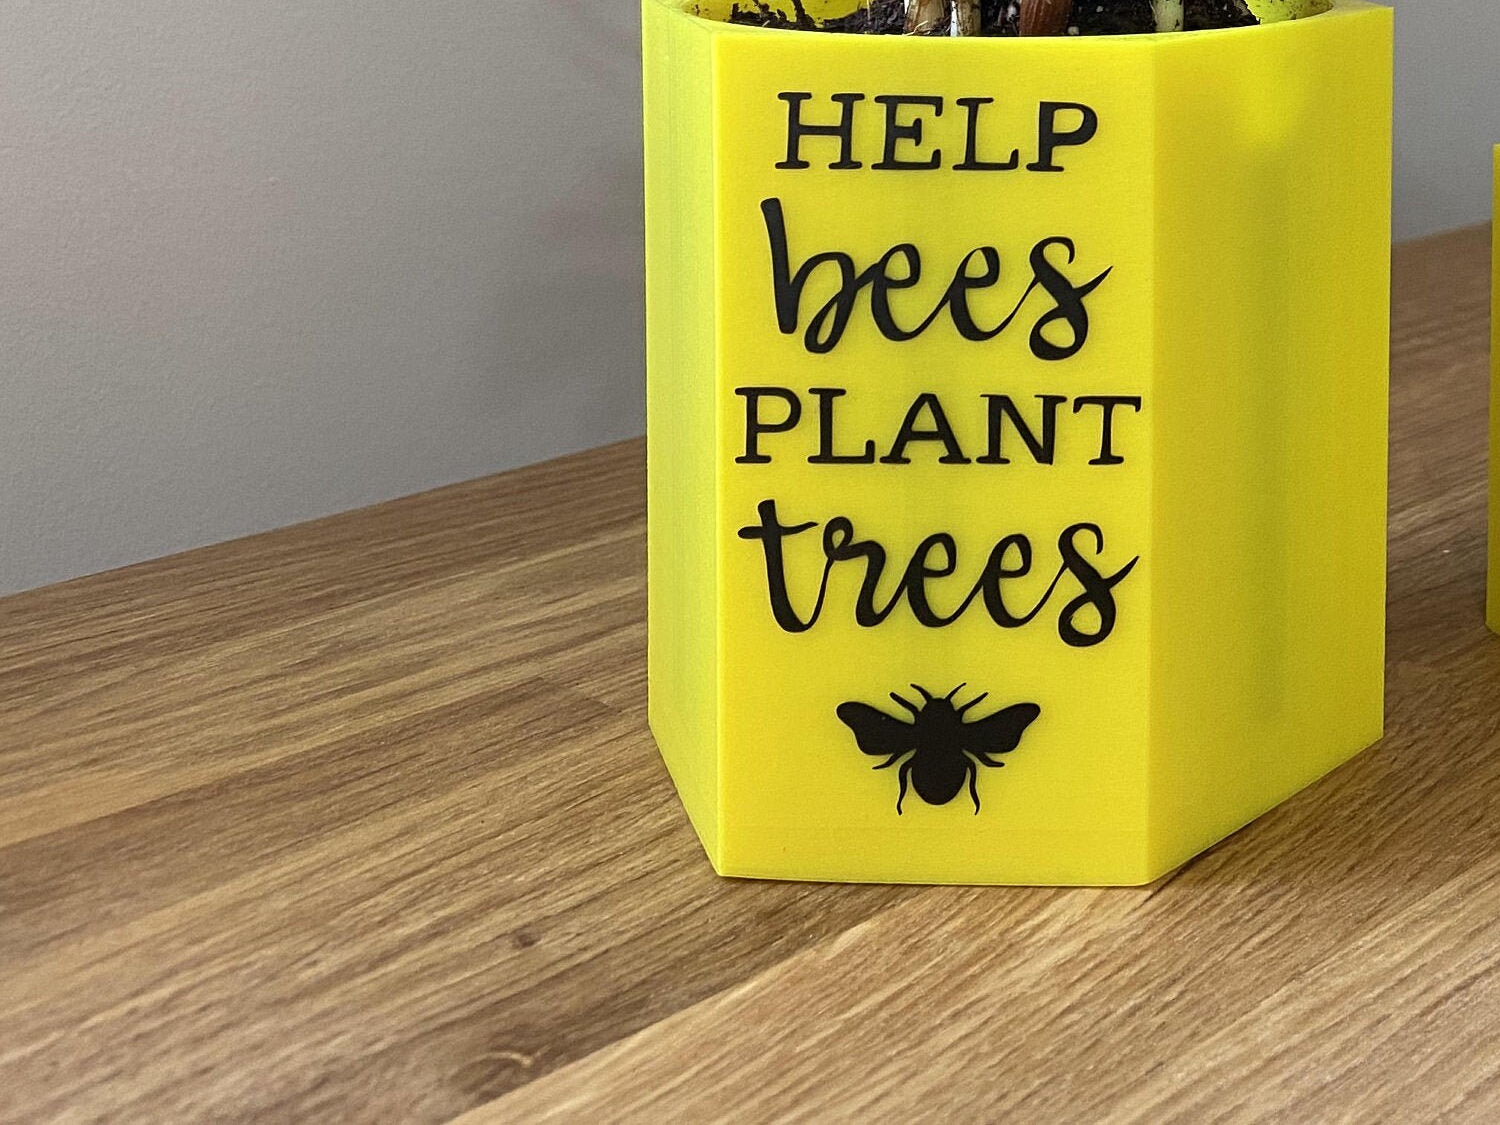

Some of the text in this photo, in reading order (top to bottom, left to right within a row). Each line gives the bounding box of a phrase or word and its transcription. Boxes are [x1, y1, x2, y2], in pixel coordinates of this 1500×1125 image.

[773, 90, 1099, 174] HELP
[759, 196, 1114, 362] bees
[733, 385, 1143, 467] PLANT
[736, 498, 1141, 649] trees
